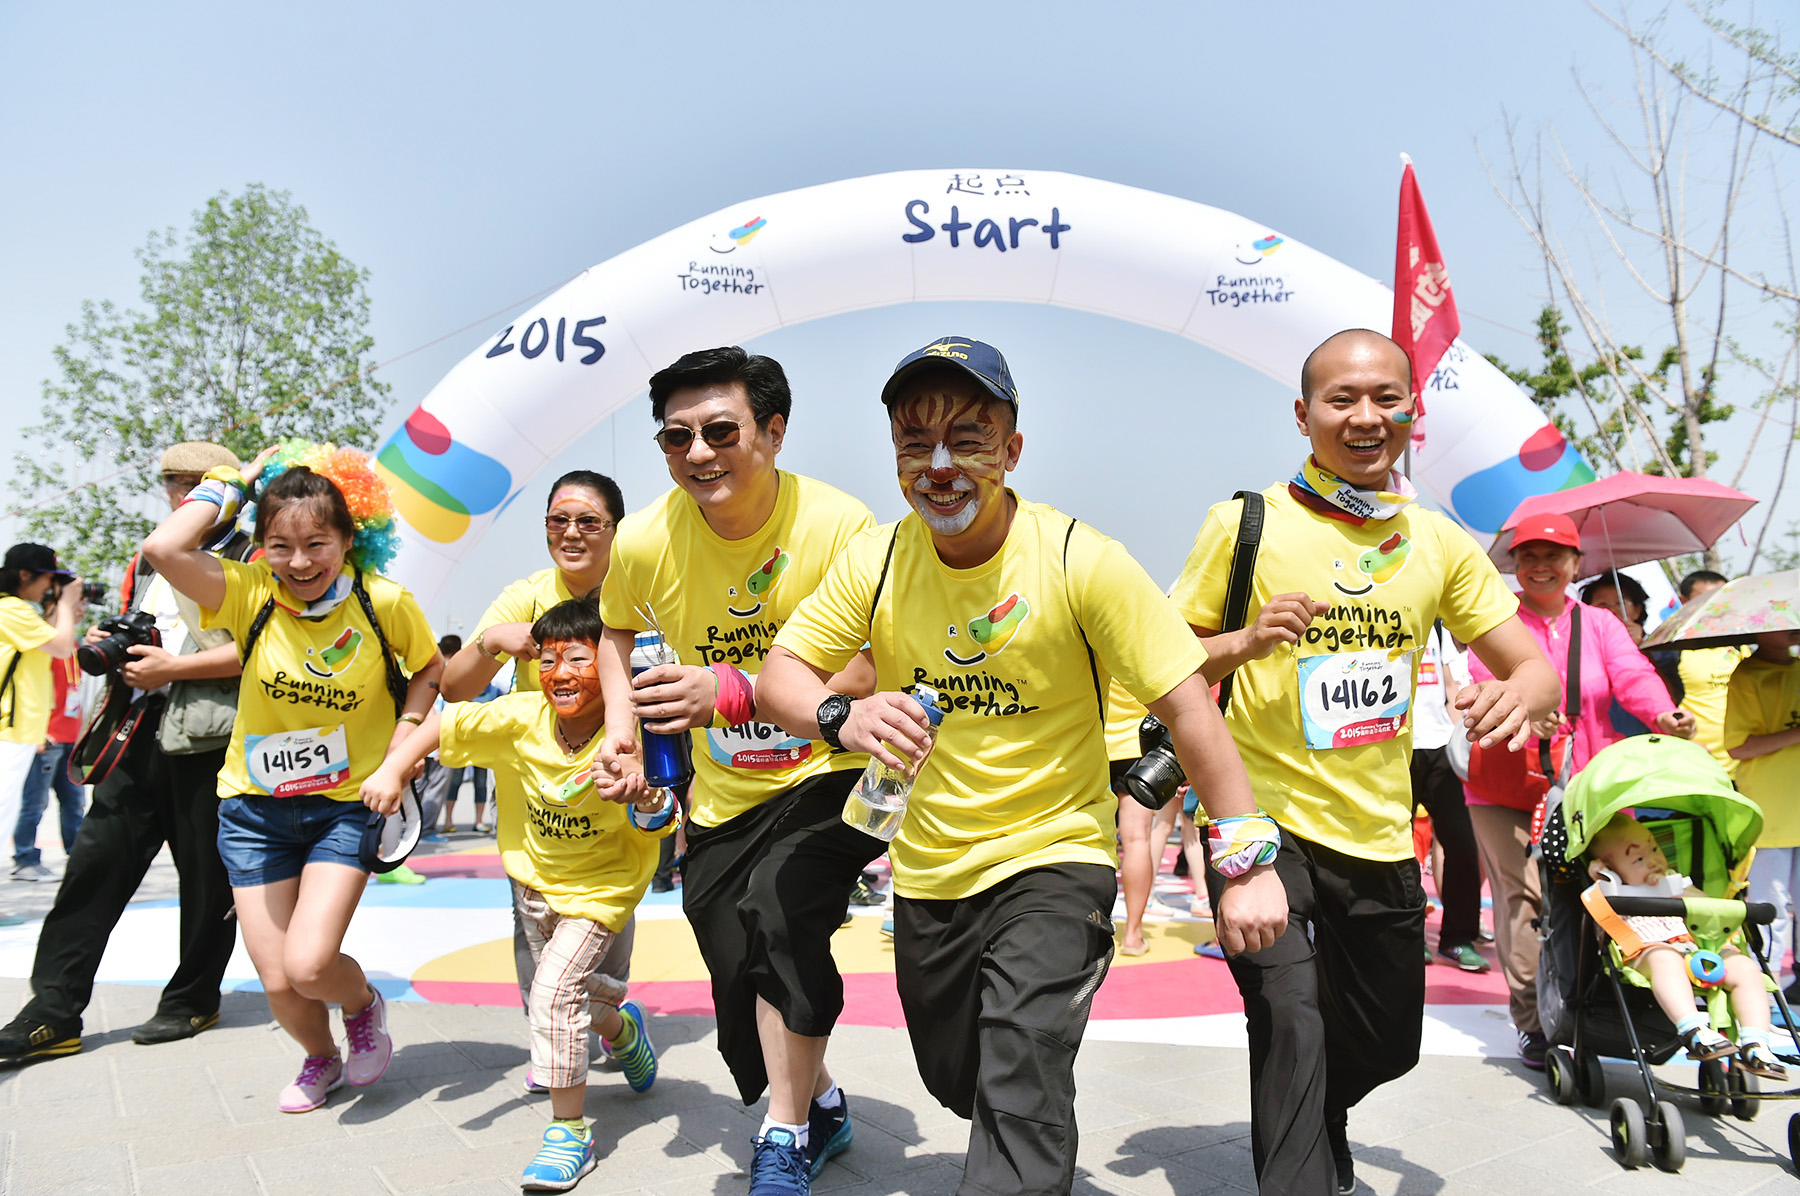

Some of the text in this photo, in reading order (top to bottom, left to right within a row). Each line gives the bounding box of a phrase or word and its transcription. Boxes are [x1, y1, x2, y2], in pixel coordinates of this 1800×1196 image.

[946, 174, 1031, 196] 起点
[902, 199, 1071, 252] Start
[689, 261, 754, 282] Running
[1217, 275, 1283, 290] Running
[677, 274, 764, 295] Together
[1206, 288, 1294, 308] Together
[485, 316, 606, 365] 2015
[1431, 366, 1459, 392] 松
[1343, 489, 1375, 514] Running
[1318, 603, 1402, 630] unning
[950, 626, 957, 636] R
[972, 629, 978, 638] T
[1297, 623, 1413, 652] ogether
[260, 680, 365, 712] Together
[274, 671, 357, 702] Running
[913, 667, 1019, 702] Running
[1321, 674, 1398, 711] 14162
[901, 685, 1040, 717] gether
[1340, 727, 1360, 739] 2015
[263, 744, 329, 773] 14159
[737, 753, 756, 763] 2015
[279, 783, 298, 793] 2015
